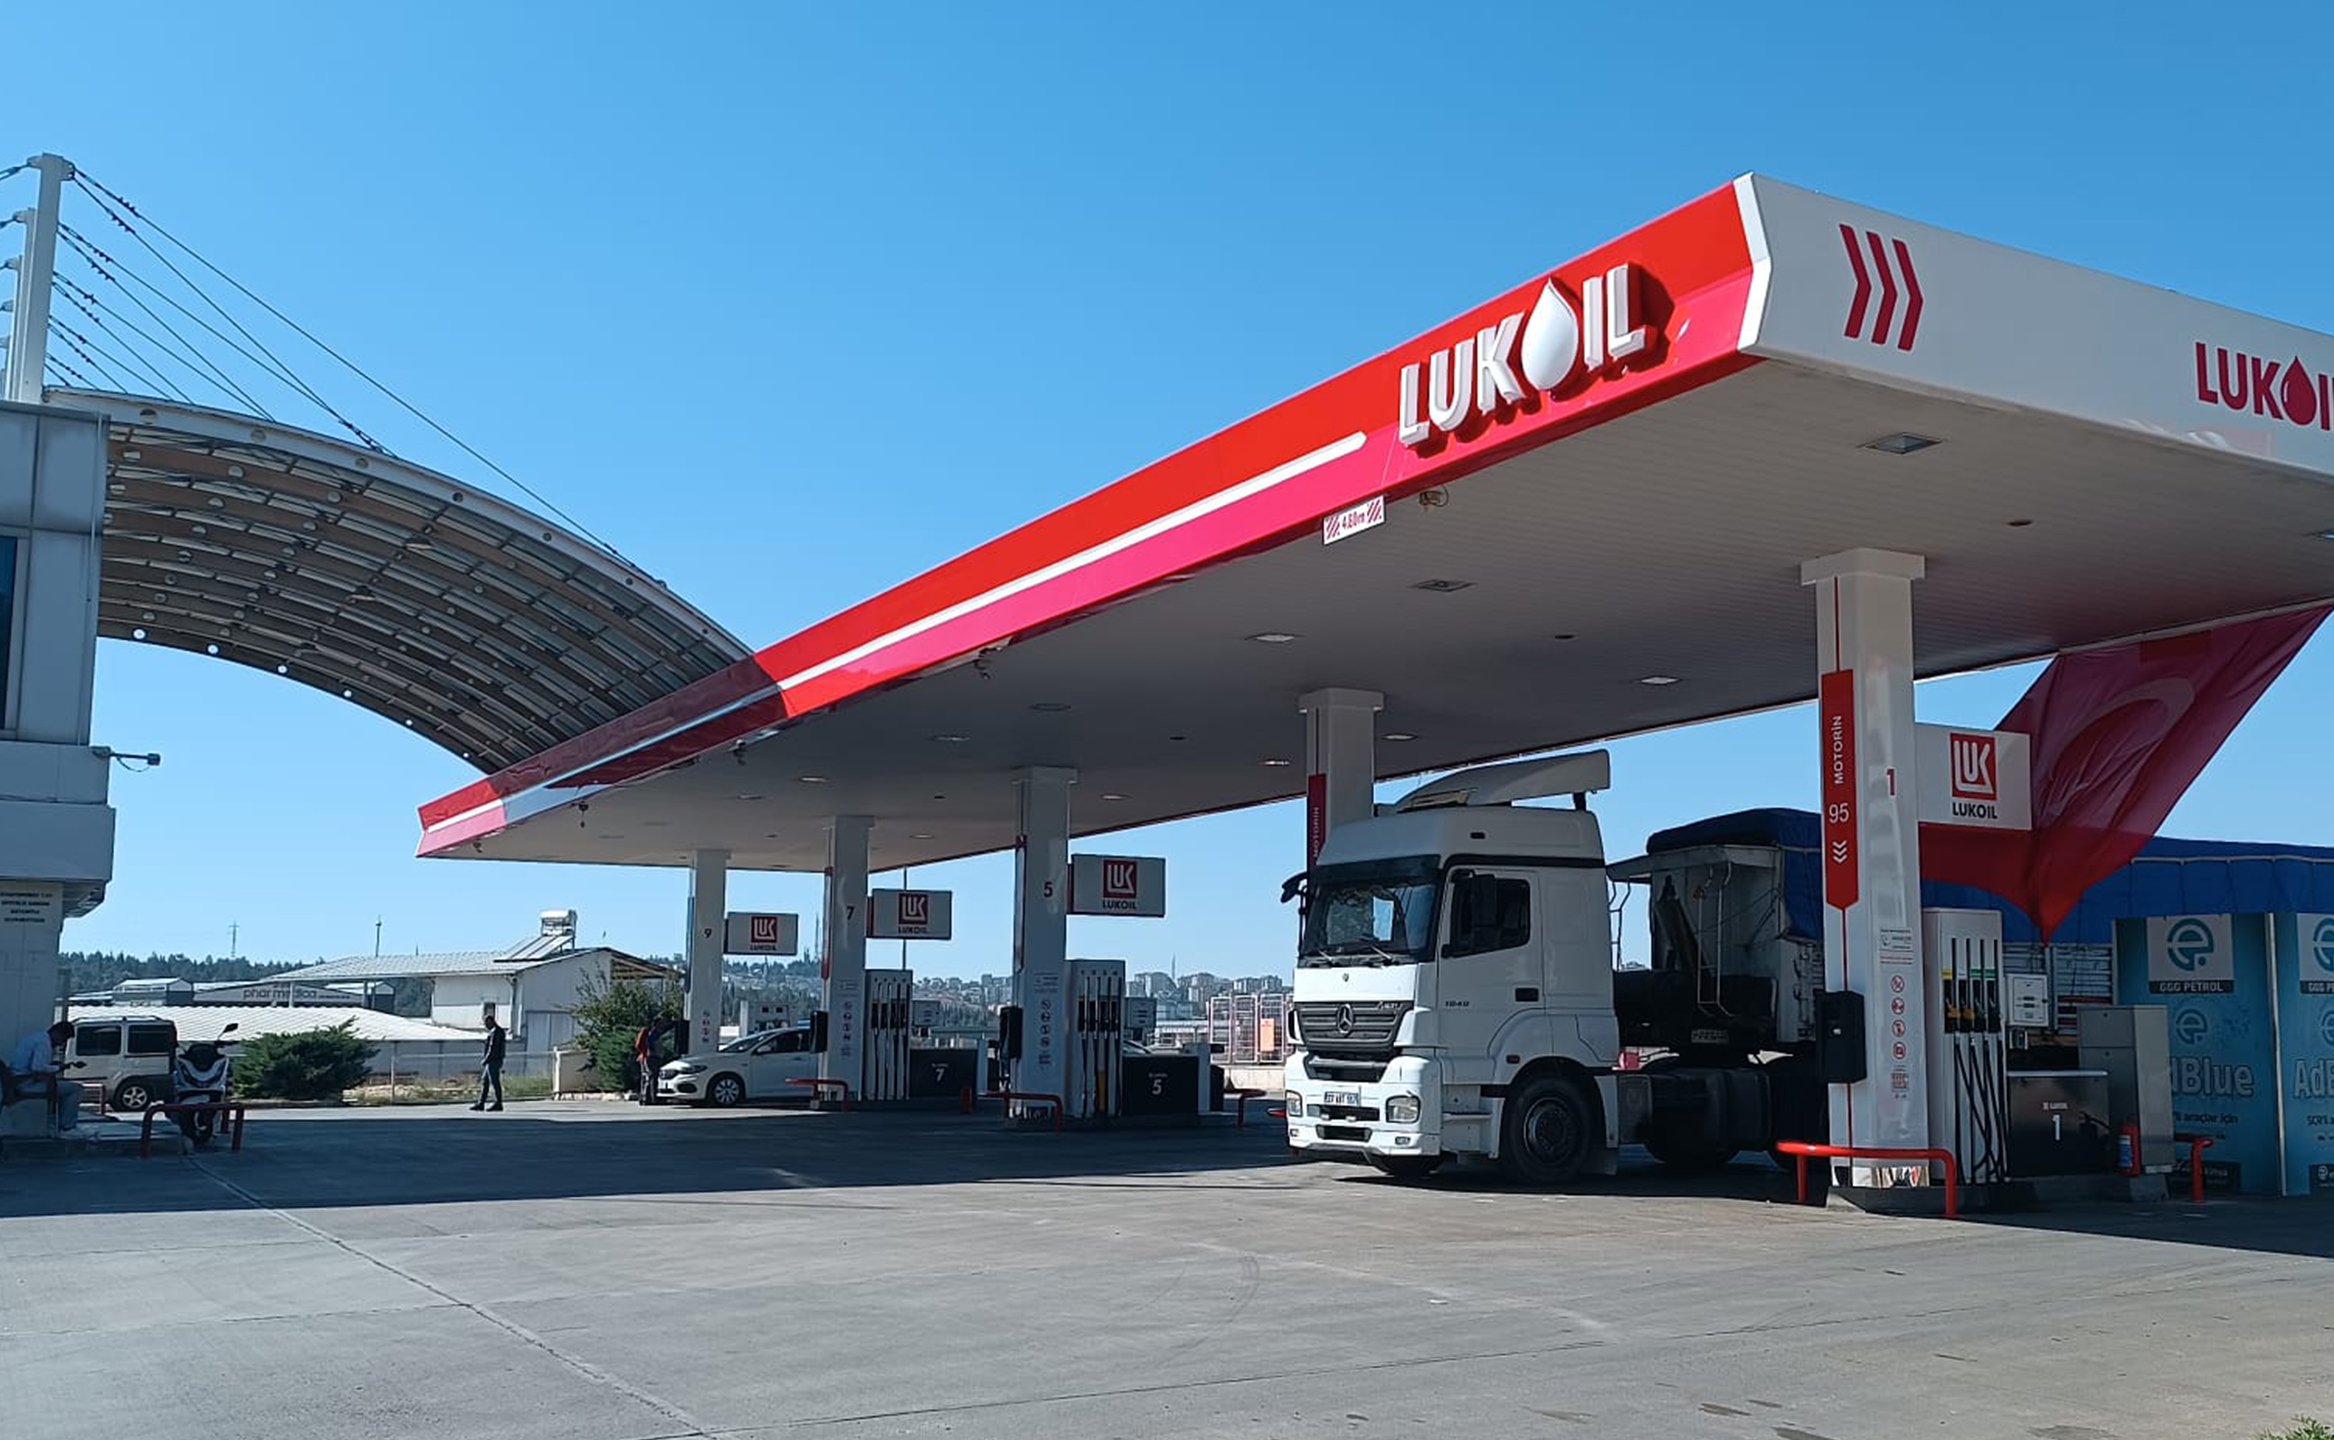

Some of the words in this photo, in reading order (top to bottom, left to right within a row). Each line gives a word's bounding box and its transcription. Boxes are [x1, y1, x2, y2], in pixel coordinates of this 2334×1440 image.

[1886, 768, 1895, 796] 1
[1829, 803, 1849, 823] 95
[1952, 802, 1998, 819] LUKOIL
[1044, 881, 1053, 898] 5
[847, 905, 855, 920] 7
[1102, 901, 1137, 910] LUKOIL
[703, 928, 712, 938] 9
[2184, 982, 2224, 992] PETROL
[936, 1068, 945, 1082] 7
[1152, 1079, 1162, 1095] 5
[2052, 1114, 2060, 1141] 1
